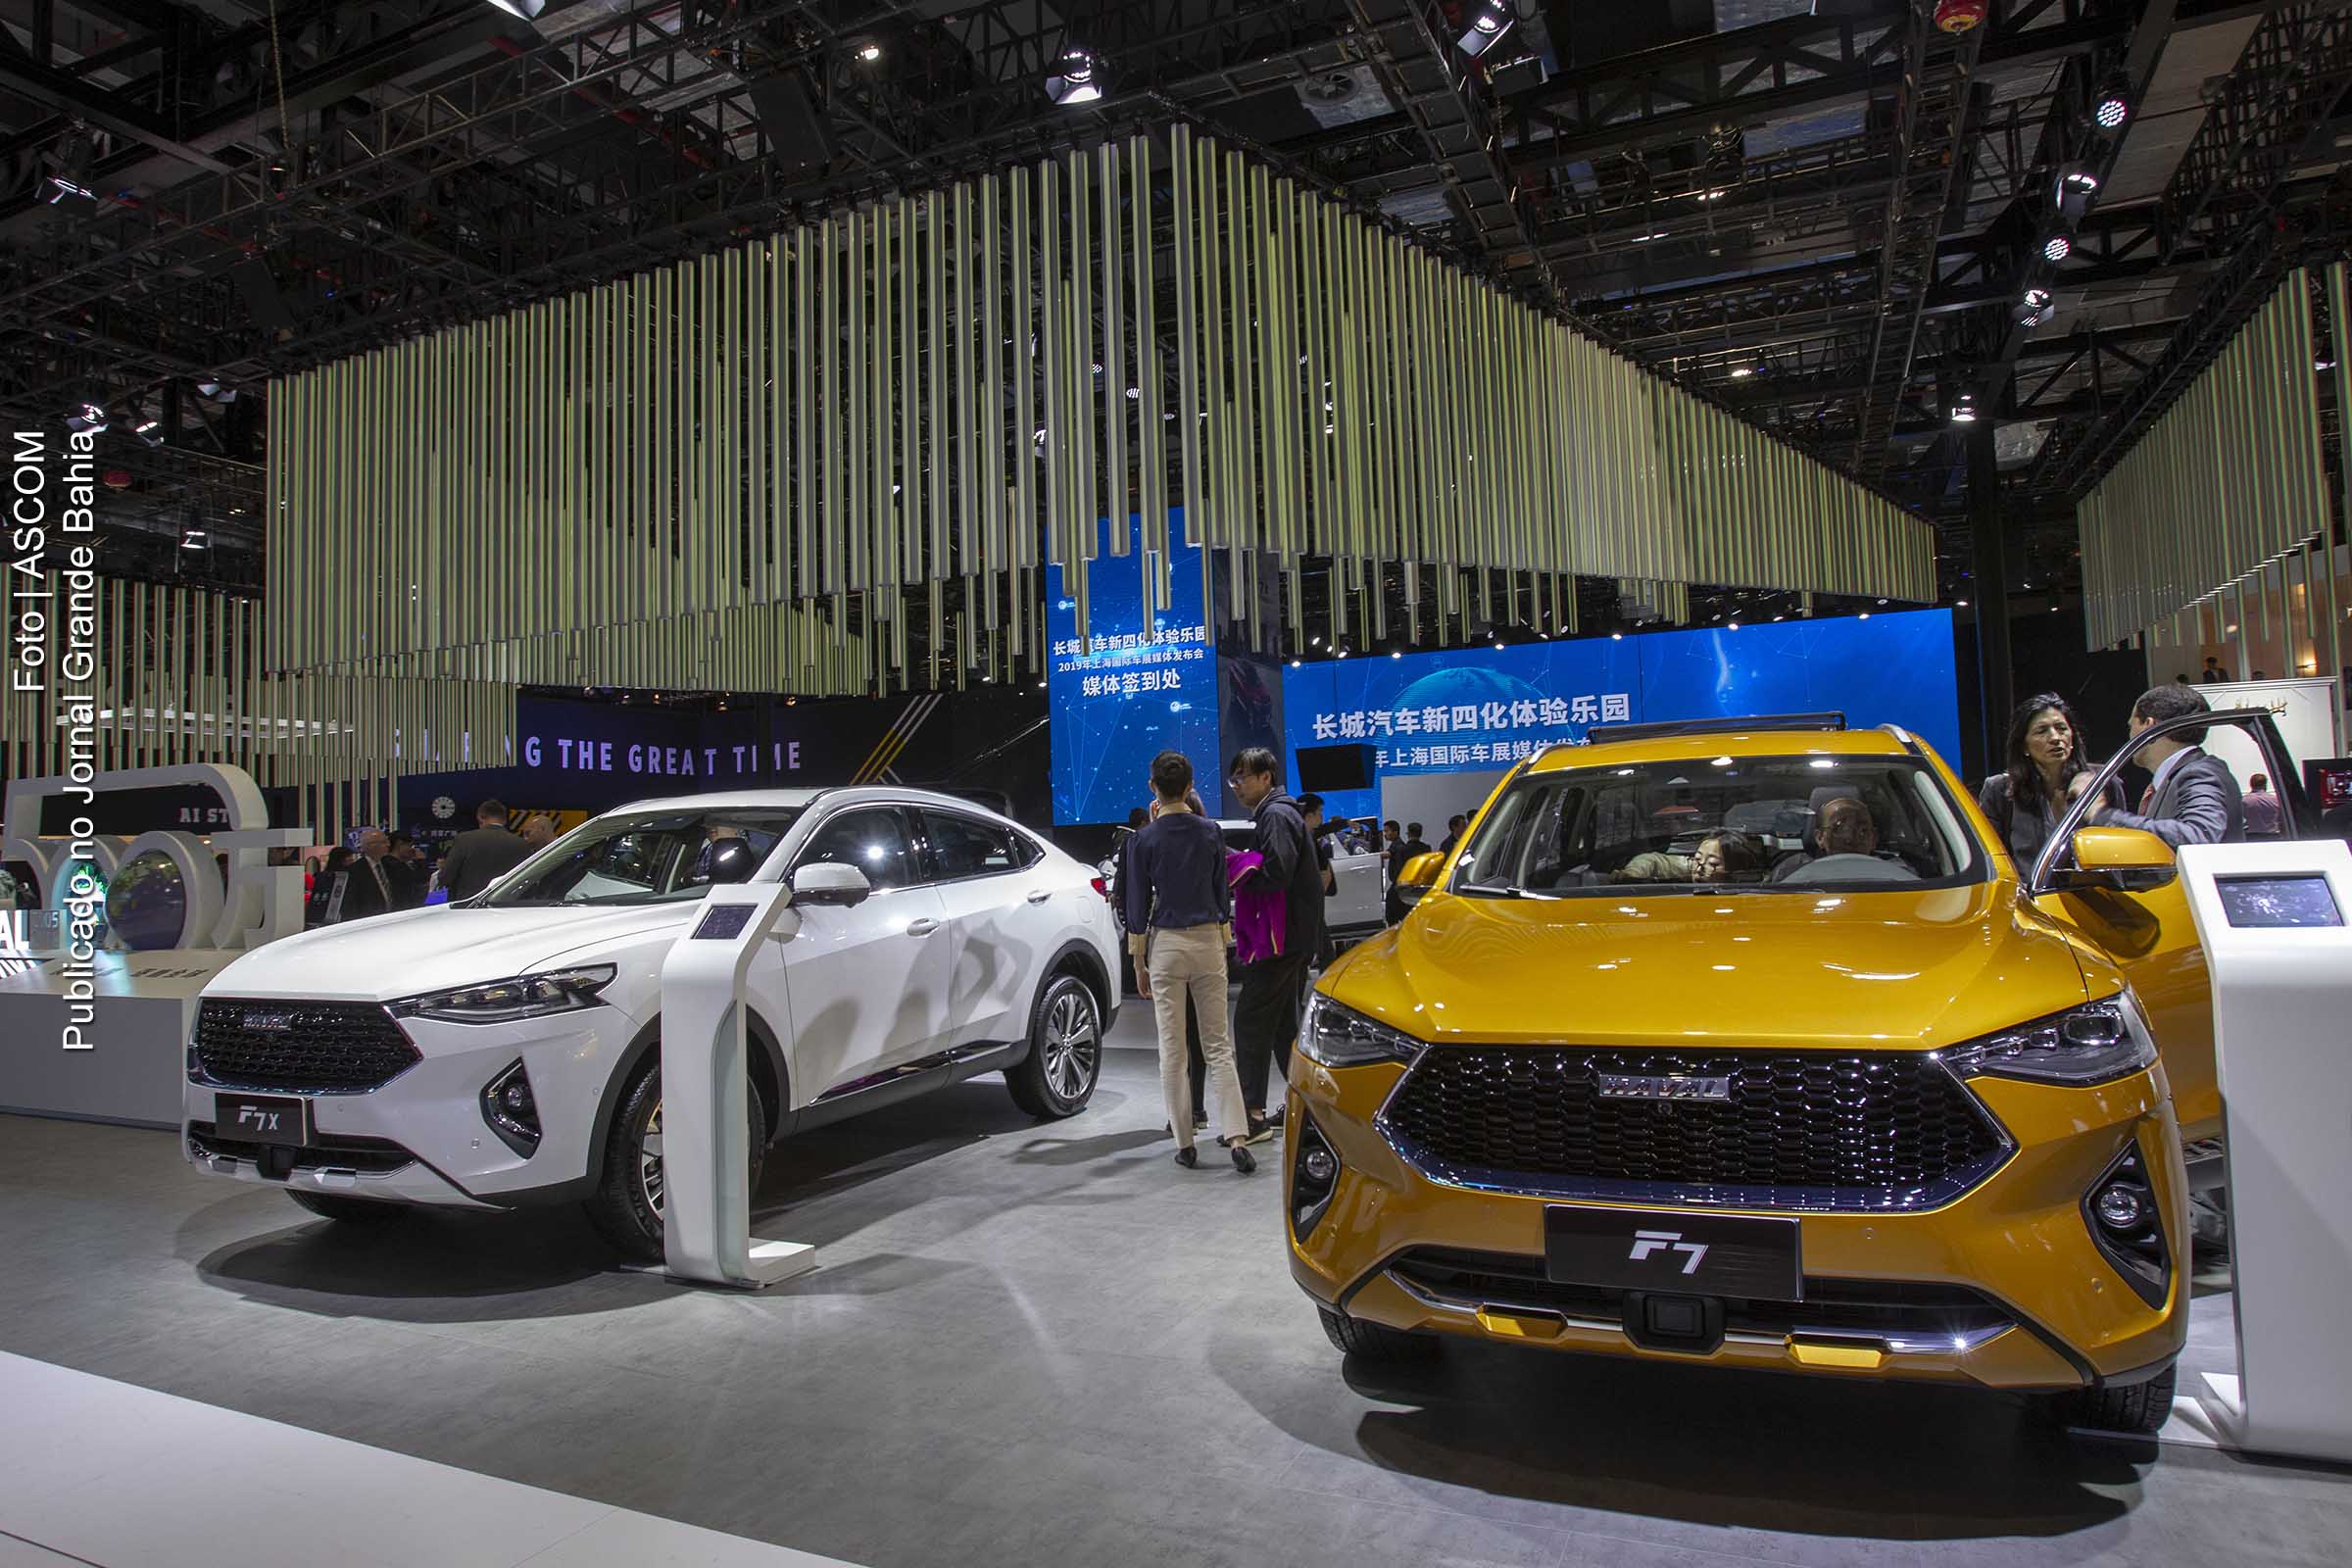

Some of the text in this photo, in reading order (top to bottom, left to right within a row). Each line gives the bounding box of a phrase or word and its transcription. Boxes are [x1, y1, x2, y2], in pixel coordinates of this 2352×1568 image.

[1082, 667, 1182, 697] 媒体签到处
[1312, 693, 1631, 740] 长城汽车新四化体验乐园
[558, 739, 612, 771] THE
[627, 744, 717, 775] GREAT
[179, 808, 201, 823] AI
[237, 1104, 280, 1132] F7X
[1628, 1230, 1709, 1275] F7
